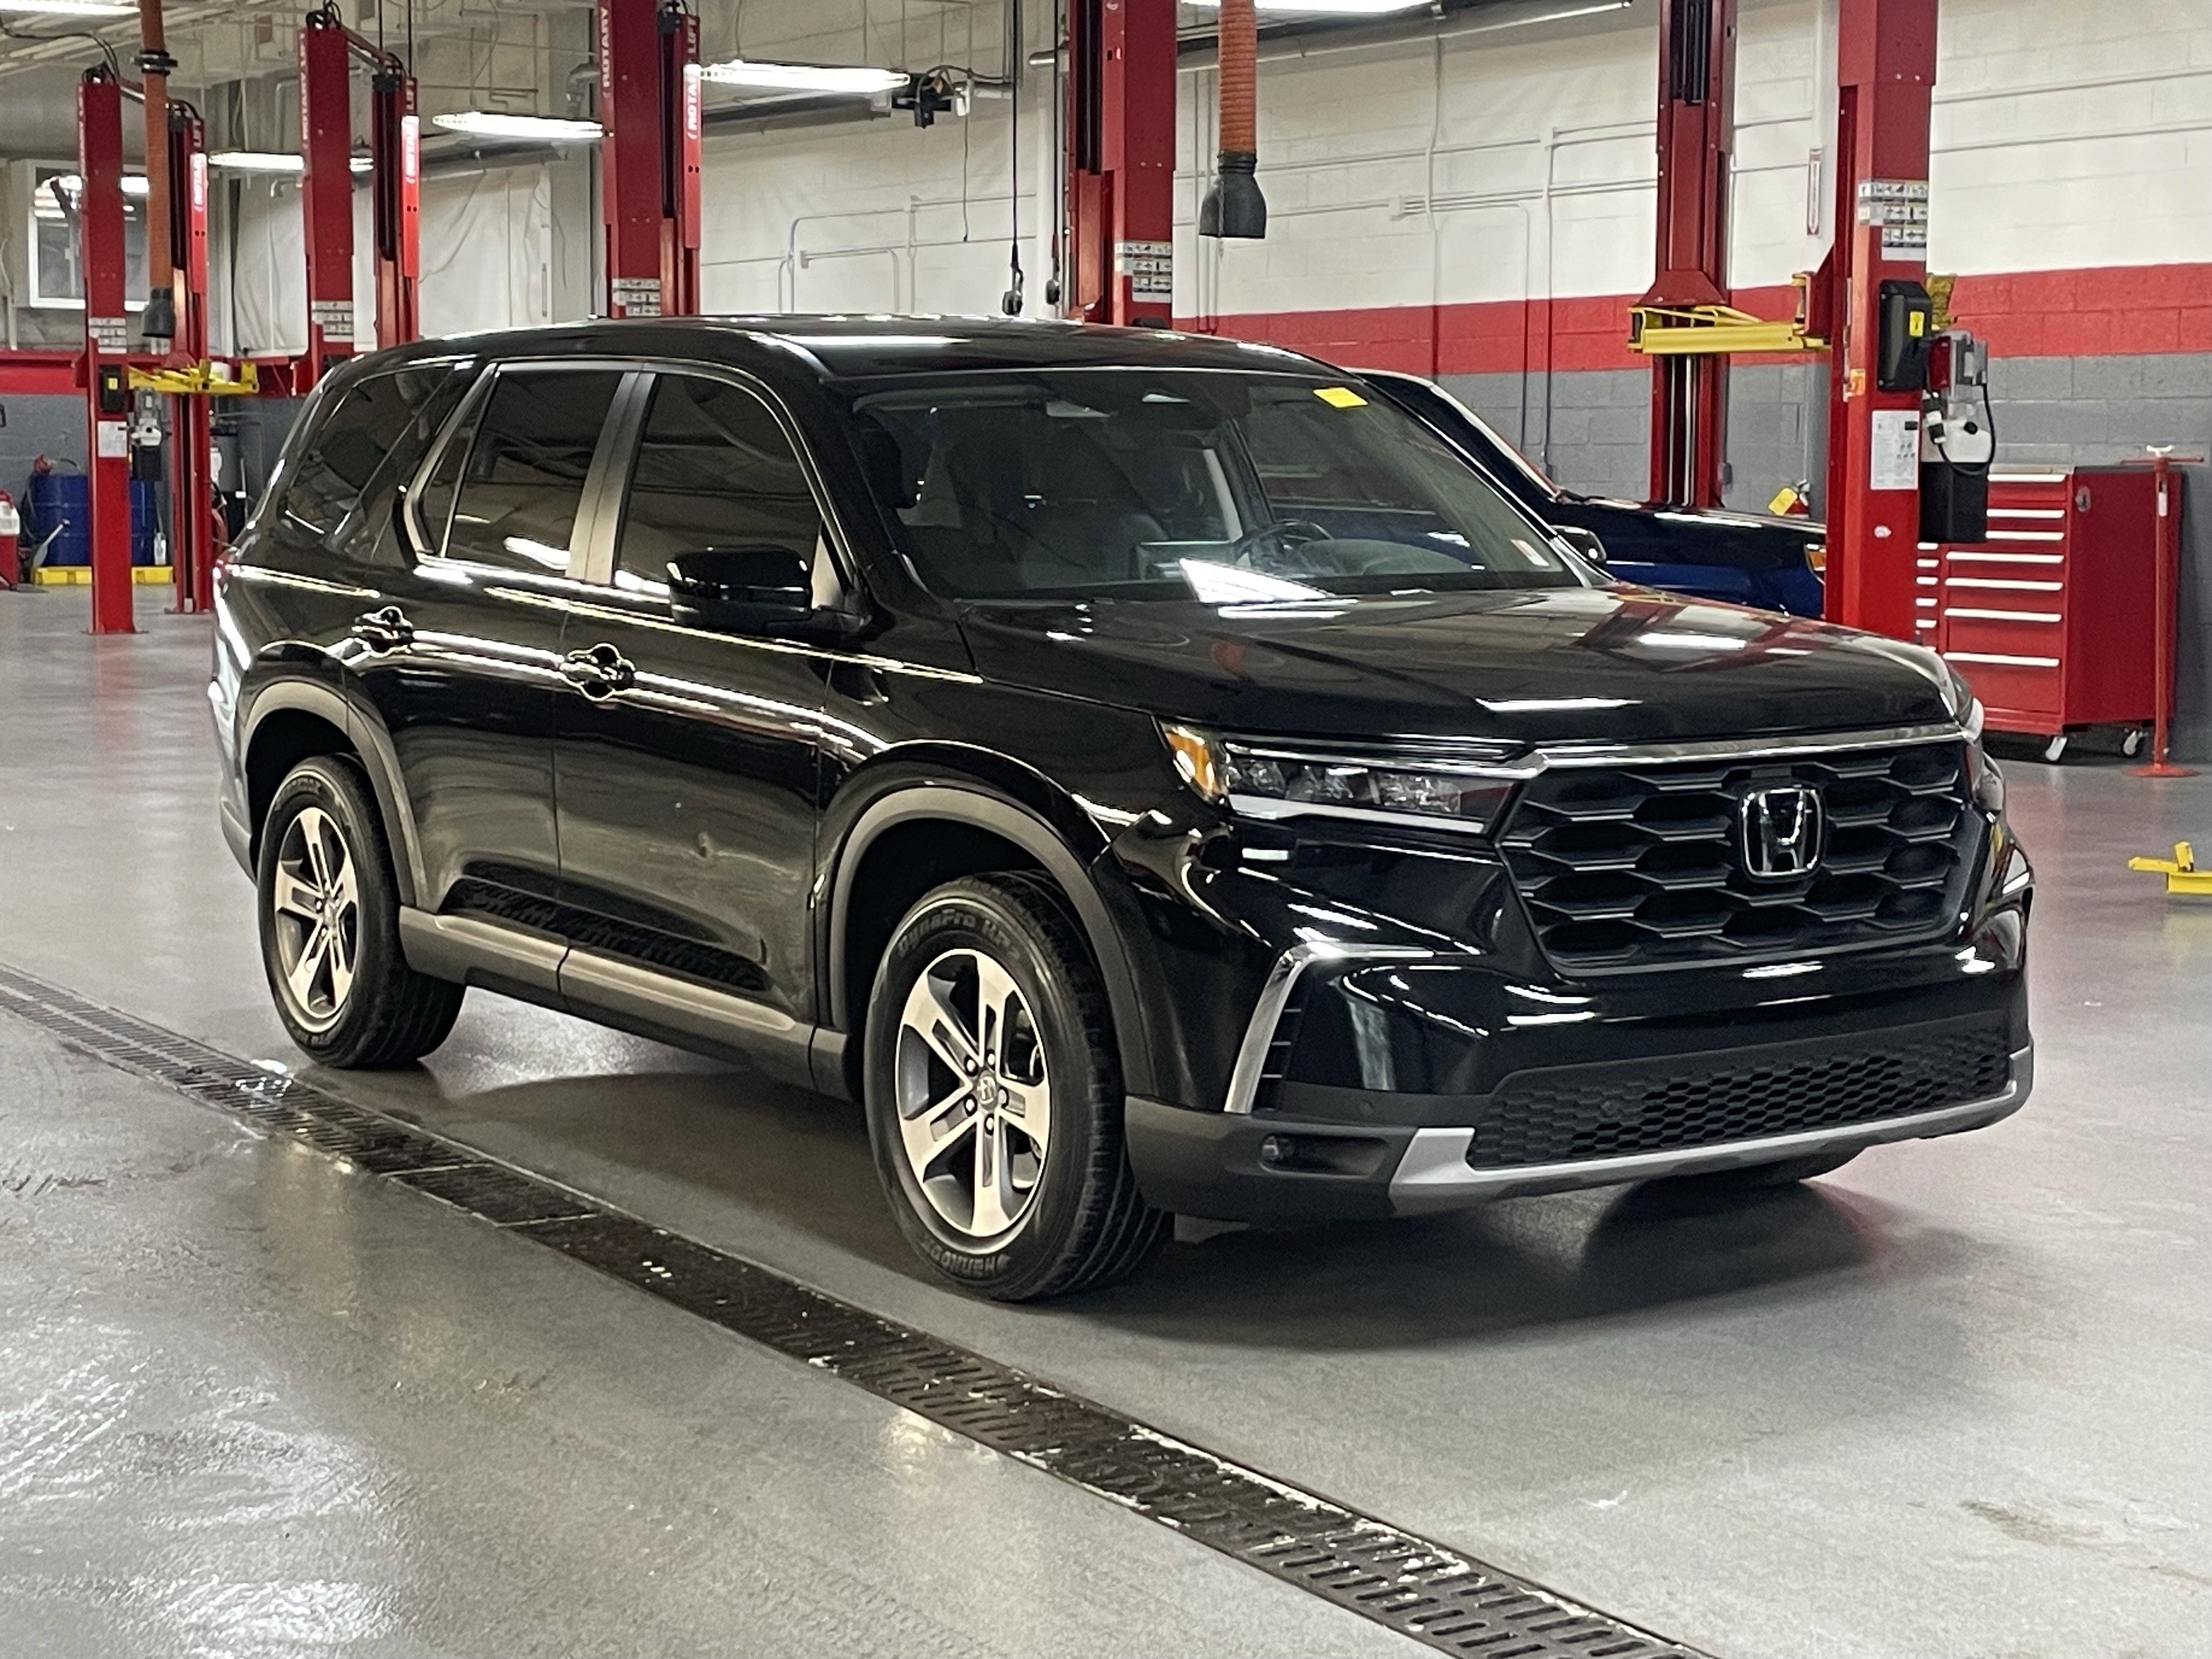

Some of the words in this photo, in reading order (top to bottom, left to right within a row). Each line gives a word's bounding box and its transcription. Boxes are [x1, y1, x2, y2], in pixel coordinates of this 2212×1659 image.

[601, 7, 611, 88] ROTARY
[687, 16, 697, 54] LIFT
[405, 77, 415, 110] LIFT
